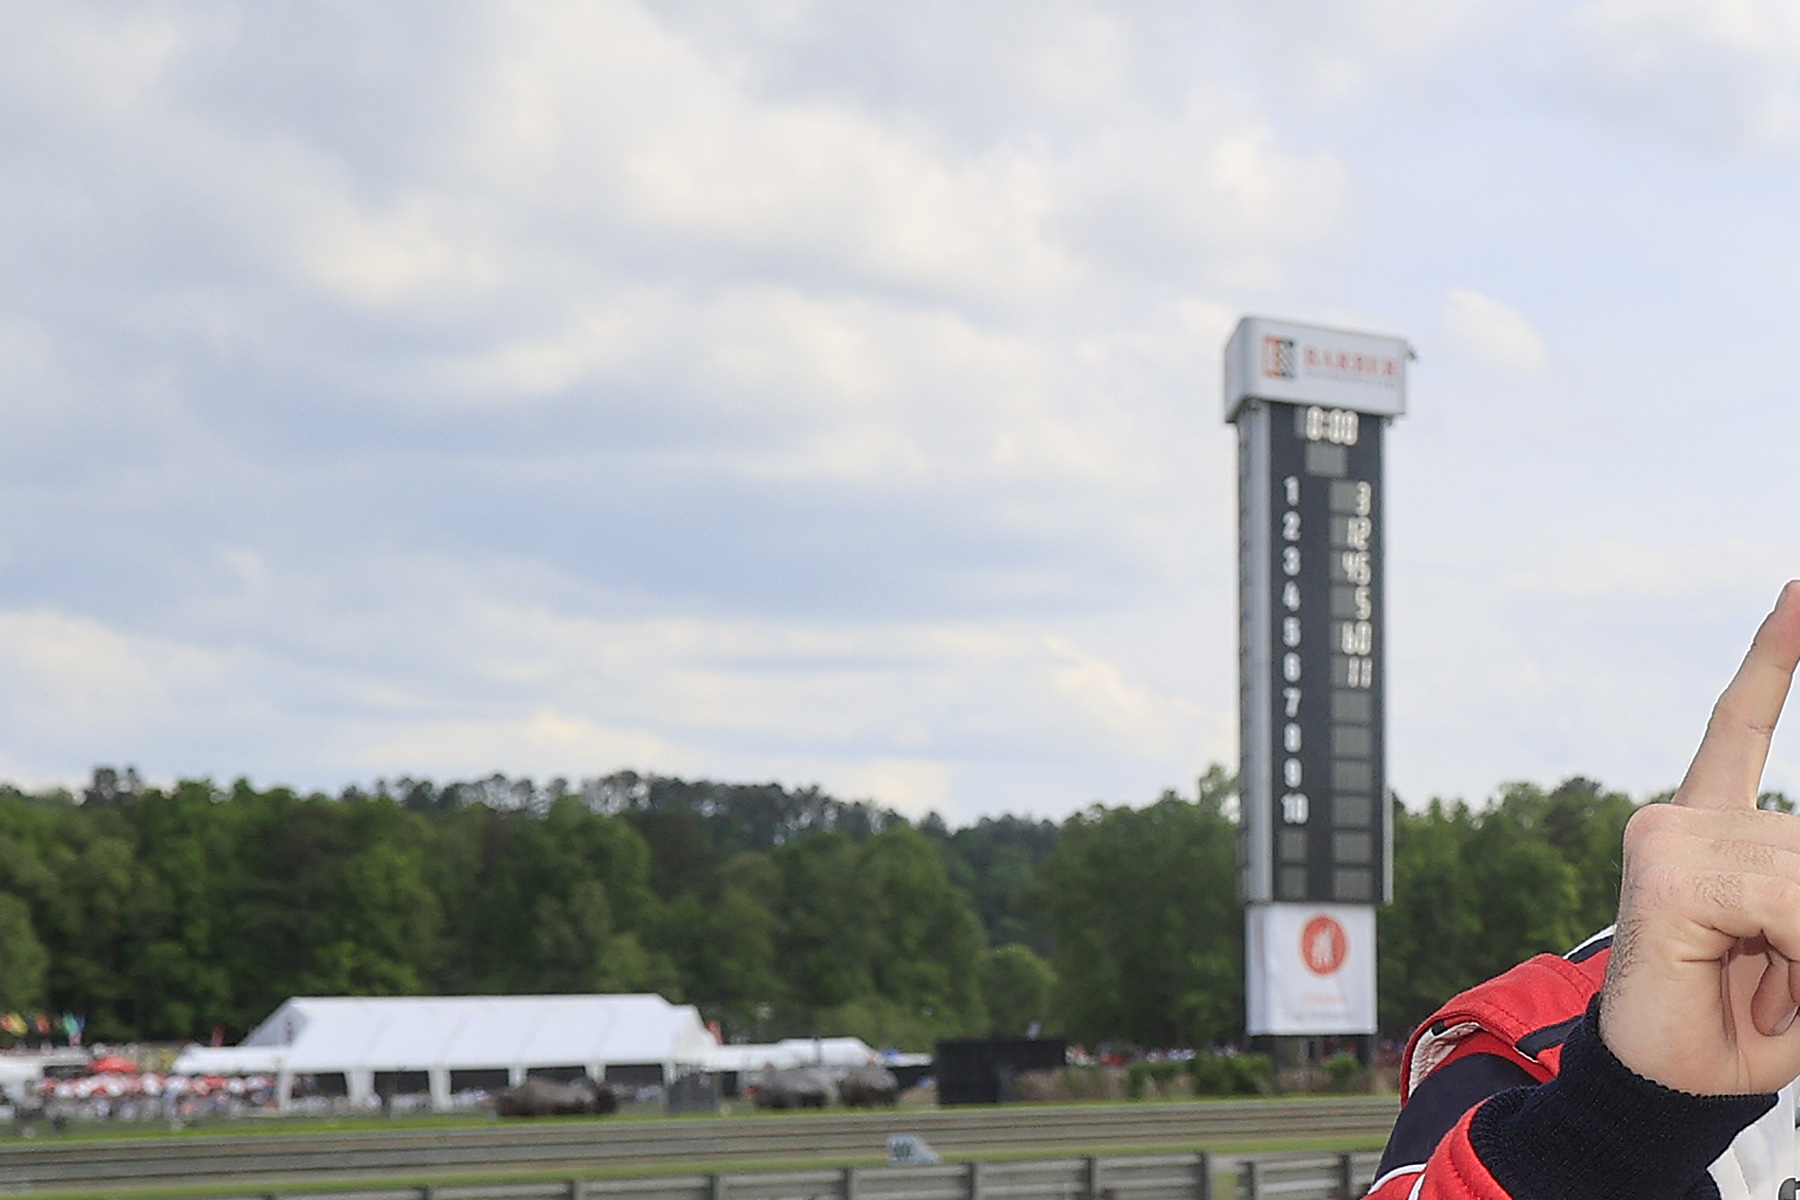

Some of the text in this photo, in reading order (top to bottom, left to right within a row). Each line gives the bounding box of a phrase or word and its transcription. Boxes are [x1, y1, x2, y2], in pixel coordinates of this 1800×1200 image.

[1283, 475, 1371, 516] 1 3
[1282, 511, 1300, 541] 2
[1282, 546, 1300, 576] 3
[1282, 581, 1371, 620] 4 5
[1282, 686, 1301, 718] 7
[1280, 792, 1309, 825] 10
